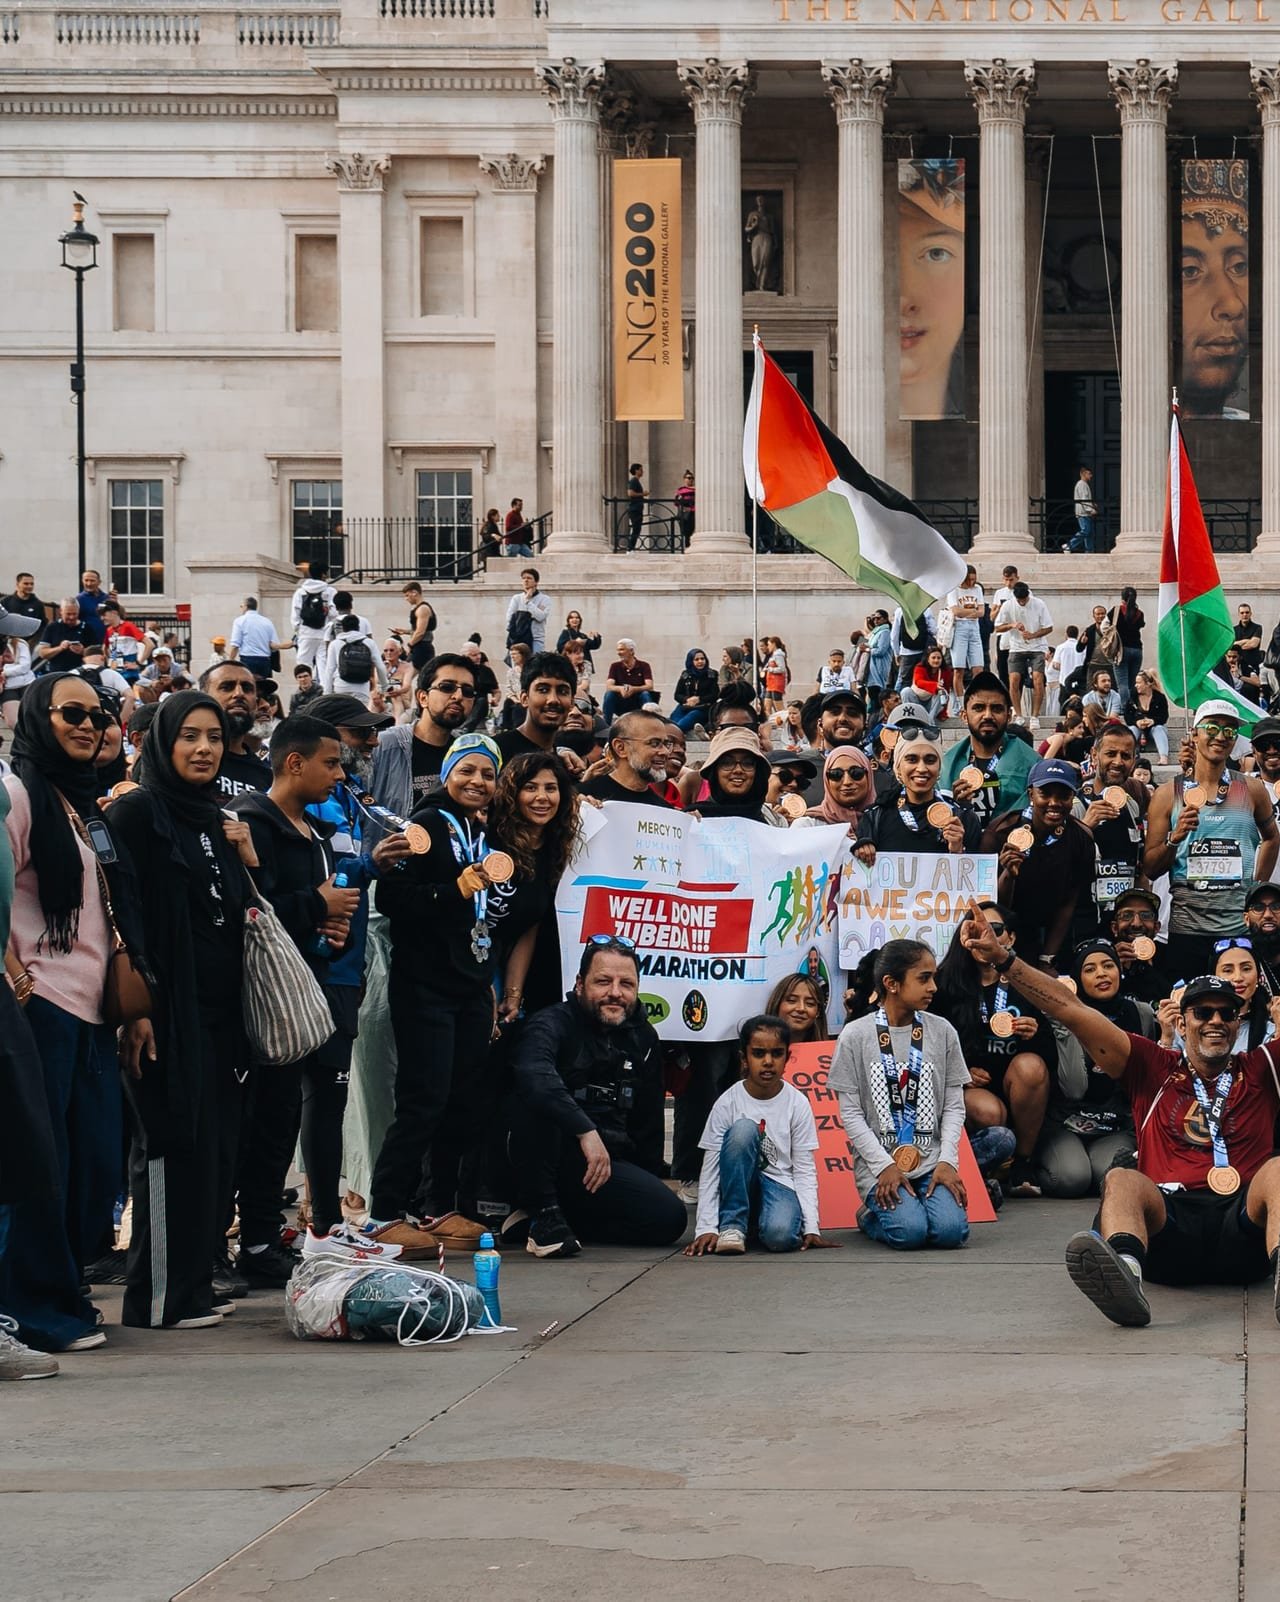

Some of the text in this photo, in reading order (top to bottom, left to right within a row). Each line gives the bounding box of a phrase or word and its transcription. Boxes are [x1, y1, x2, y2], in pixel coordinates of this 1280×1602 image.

[773, 0, 860, 21] THE
[891, 0, 1128, 22] NATIONAL
[625, 202, 657, 365] NG200
[661, 202, 670, 366] 200 YEARS OF THE NATIONAL GALLERY
[637, 820, 683, 840] MERCY TO
[857, 856, 997, 892] YOU ARE
[1196, 861, 1233, 874] 37797
[608, 894, 718, 928] WELL DONE
[638, 954, 746, 981] MARATHON
